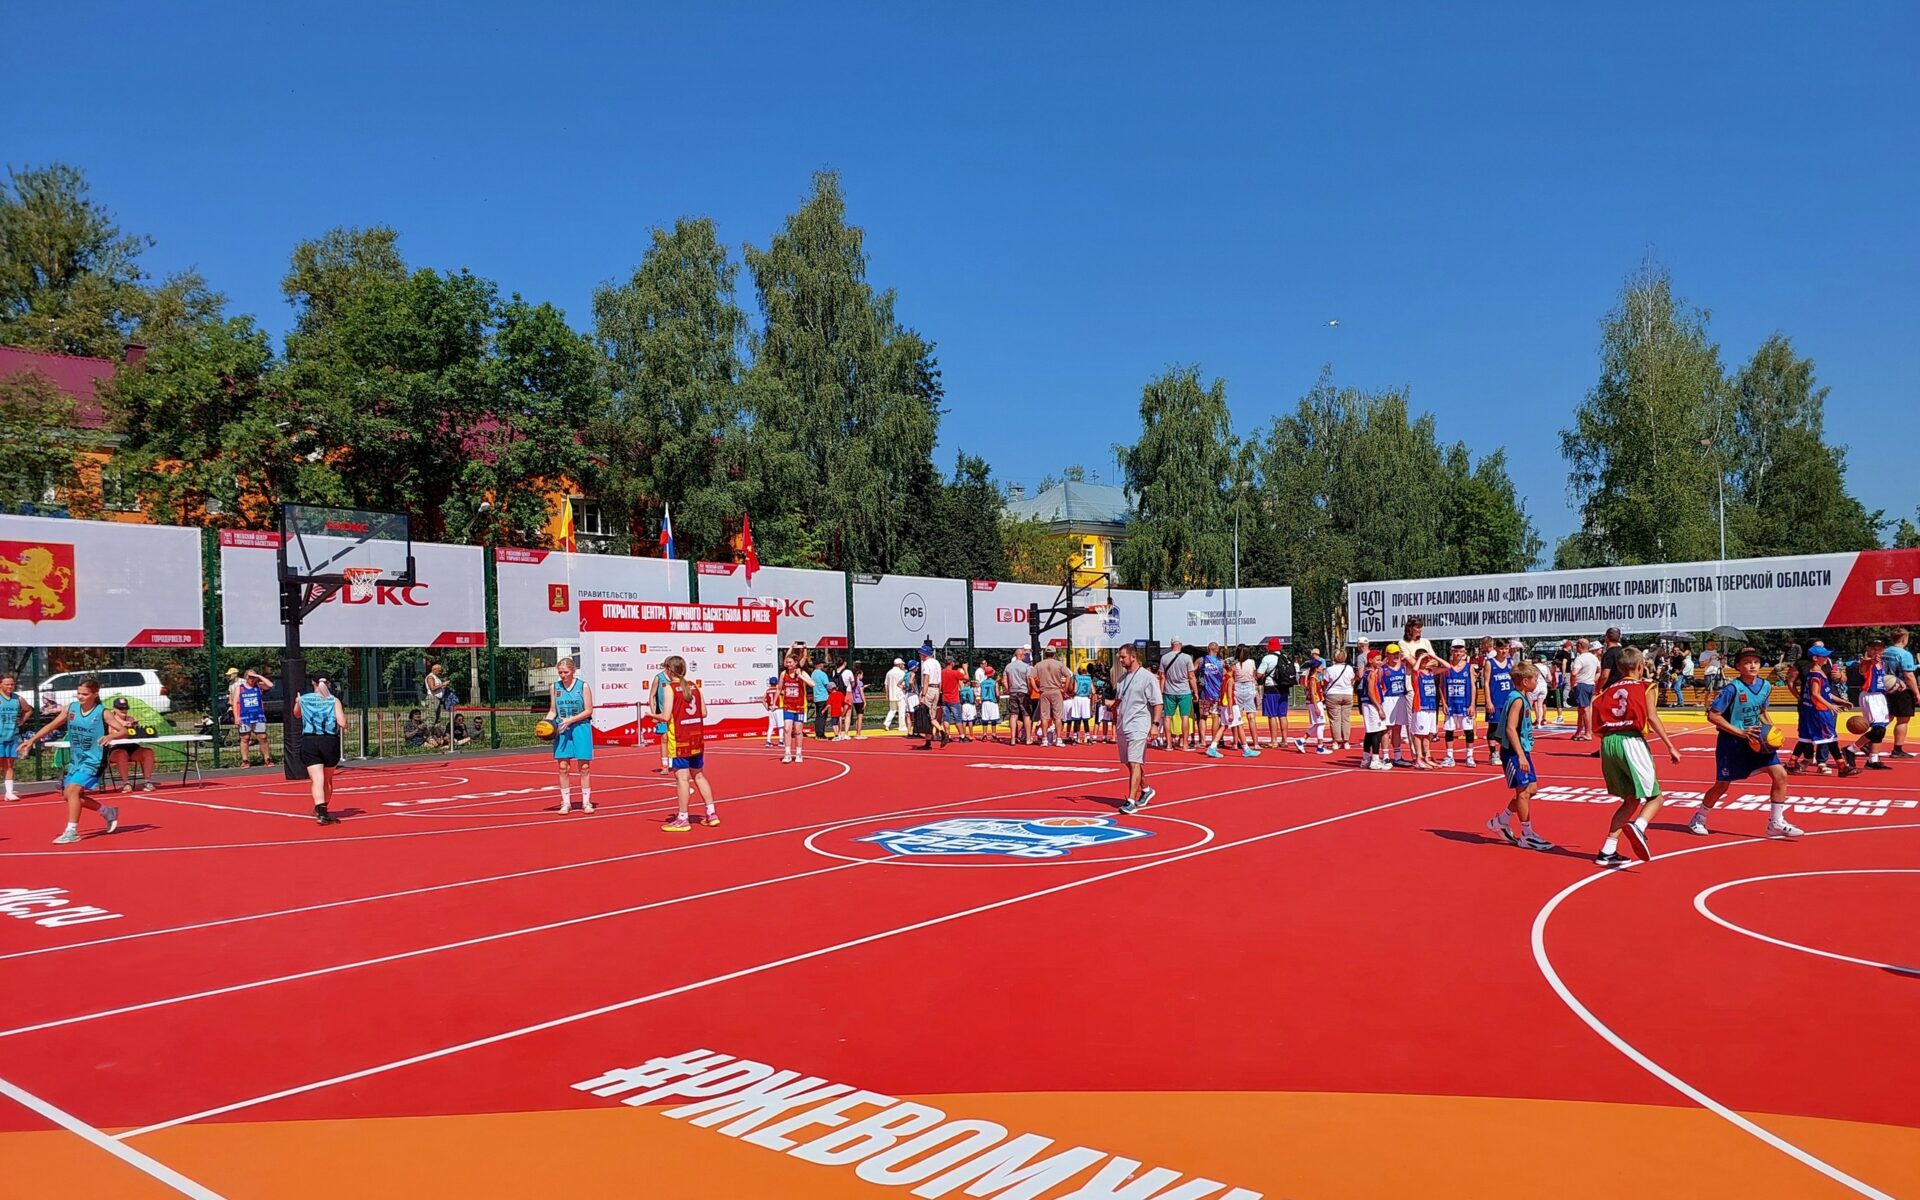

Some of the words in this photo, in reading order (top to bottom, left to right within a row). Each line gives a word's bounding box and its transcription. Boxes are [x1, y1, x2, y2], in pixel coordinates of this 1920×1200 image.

[578, 590, 638, 599] ПРАВИТЕЛЬСТВО
[1392, 592, 1424, 607] ПРОЕКТ
[1426, 589, 1485, 606] РЕАЛИЗОВАН
[1487, 588, 1500, 602] АО
[1502, 586, 1534, 602] «ДКС»
[1537, 585, 1556, 600] ПРИ
[1559, 581, 1621, 599] ПОДДЕРЖКЕ
[1624, 576, 1713, 597] ПРАВИТЕЛЬСТВА
[1716, 570, 1773, 591] ТВЕРСКОЙ
[1776, 569, 1831, 588] ОБЛАСТИ
[602, 604, 640, 619] ОТКРЫТИЕ
[641, 605, 667, 620] ЦЕНТРА
[668, 606, 701, 621] УЛИЧНОГО
[702, 607, 741, 622] БАСКЕТБОЛА
[742, 608, 751, 622] ВО
[751, 609, 770, 623] РЖЕВЕ
[904, 607, 923, 617] РФБ
[1392, 614, 1398, 628] И
[1482, 607, 1536, 625] РЖЕВСКОГО
[1539, 604, 1634, 622] МУНИЦИПАЛЬНОГО
[1637, 602, 1677, 619] ОКРУГА
[1361, 617, 1381, 633] ЦУБ
[984, 686, 991, 696] 7
[1081, 683, 1088, 694] 3
[1500, 681, 1510, 691] 33
[685, 695, 697, 715] 3
[1611, 688, 1629, 717] 3
[856, 830, 1066, 858] ТВЕРЬ
